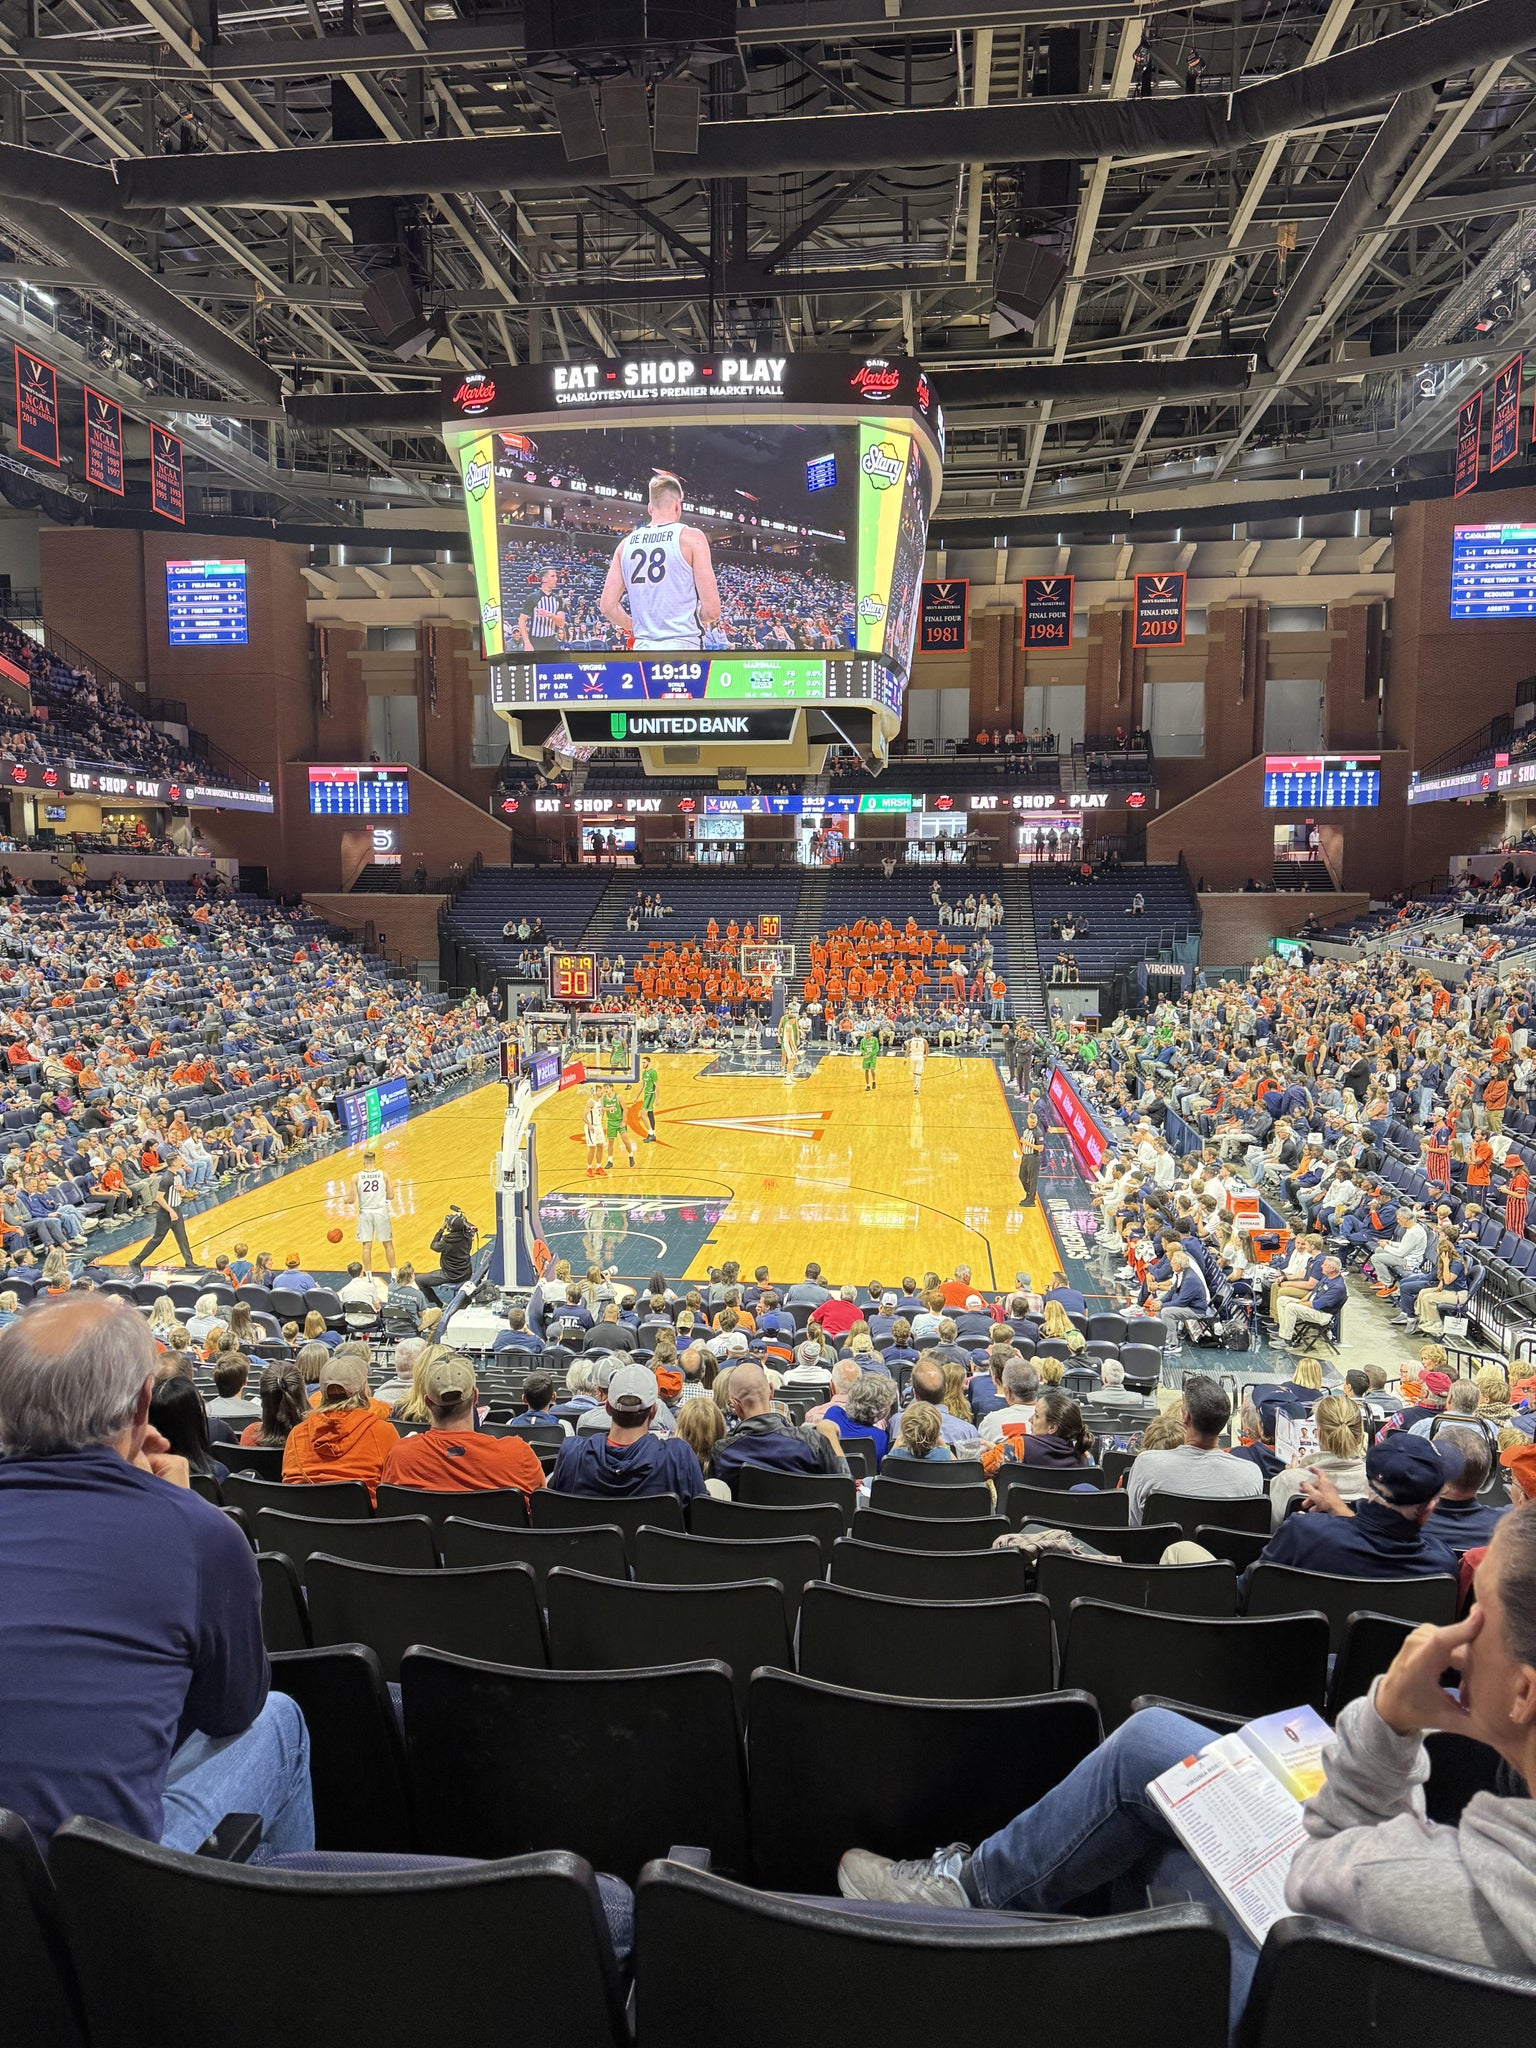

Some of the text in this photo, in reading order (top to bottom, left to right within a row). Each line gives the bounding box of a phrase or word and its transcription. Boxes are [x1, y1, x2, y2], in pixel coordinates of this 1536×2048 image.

[554, 358, 787, 390] EAT SHOP PLAY
[850, 367, 899, 393] Market
[452, 381, 496, 404] Market
[556, 385, 784, 404] CHARLOTTESVILLE'S PREMIER MARKET HALL
[25, 392, 51, 415] NCAA
[22, 412, 37, 427] 2018
[93, 429, 116, 450] NCAA
[158, 462, 177, 480] NCAA
[495, 467, 512, 478] LAY
[862, 444, 904, 484] Starry
[465, 460, 491, 492] Starry
[571, 480, 643, 502] EAT SHOP PLAY
[630, 531, 674, 544] DE RIDDER
[630, 548, 666, 584] 28
[858, 595, 887, 620] Starry
[926, 628, 958, 642] 1981
[1029, 624, 1064, 639] 1984
[1141, 620, 1178, 636] 2019
[651, 663, 701, 680] 19:19
[720, 673, 731, 687] 0
[622, 673, 633, 689] 2
[630, 717, 750, 734] UNITED BANK
[1497, 769, 1513, 786] EAT
[1518, 765, 1536, 783] SHO
[70, 773, 90, 789] EAT
[100, 776, 127, 793] SHOP
[136, 780, 159, 797] PLAY
[535, 799, 662, 811] EAT SHOP PLAY
[720, 799, 760, 810] UVA 2
[868, 798, 911, 809] 0 MRSH
[971, 794, 1108, 809] EAT SHOP PLAY
[762, 923, 777, 935] 30
[559, 957, 591, 970] 19:19
[1145, 963, 1186, 975] VIRGINIA
[560, 971, 588, 995] 30
[362, 1180, 379, 1192] 28
